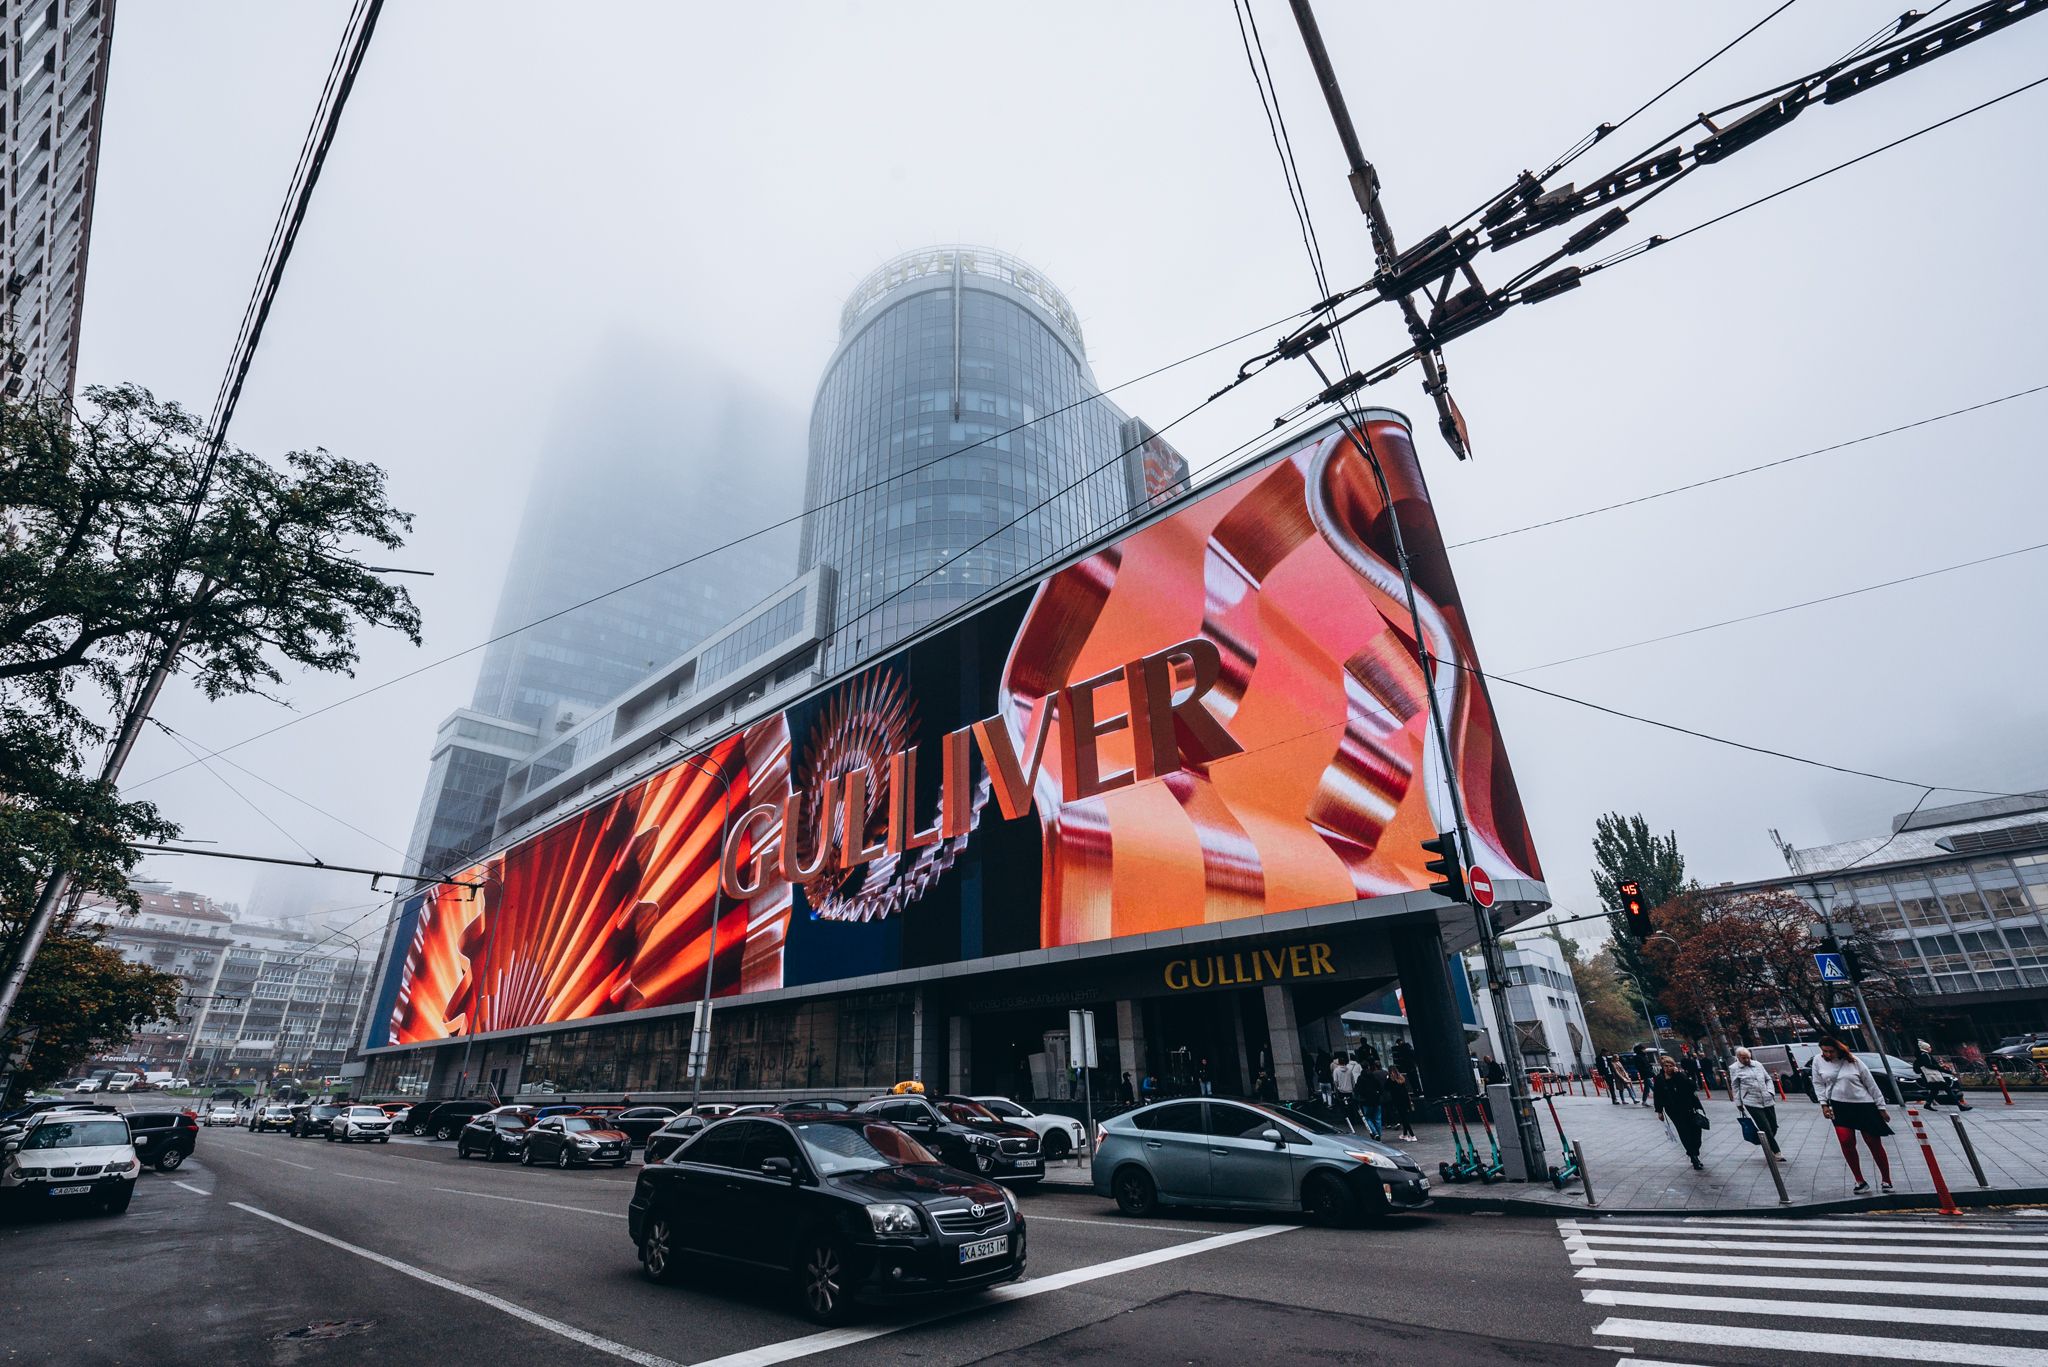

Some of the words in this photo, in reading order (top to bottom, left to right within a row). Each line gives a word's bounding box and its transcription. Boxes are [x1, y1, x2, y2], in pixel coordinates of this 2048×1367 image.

[721, 636, 1244, 900] GULLIVER
[1621, 884, 1637, 895] 45
[1163, 941, 1337, 991] GULLIVER
[965, 1247, 976, 1259] KA
[977, 1242, 995, 1257] 5213
[996, 1239, 1006, 1251] IM
